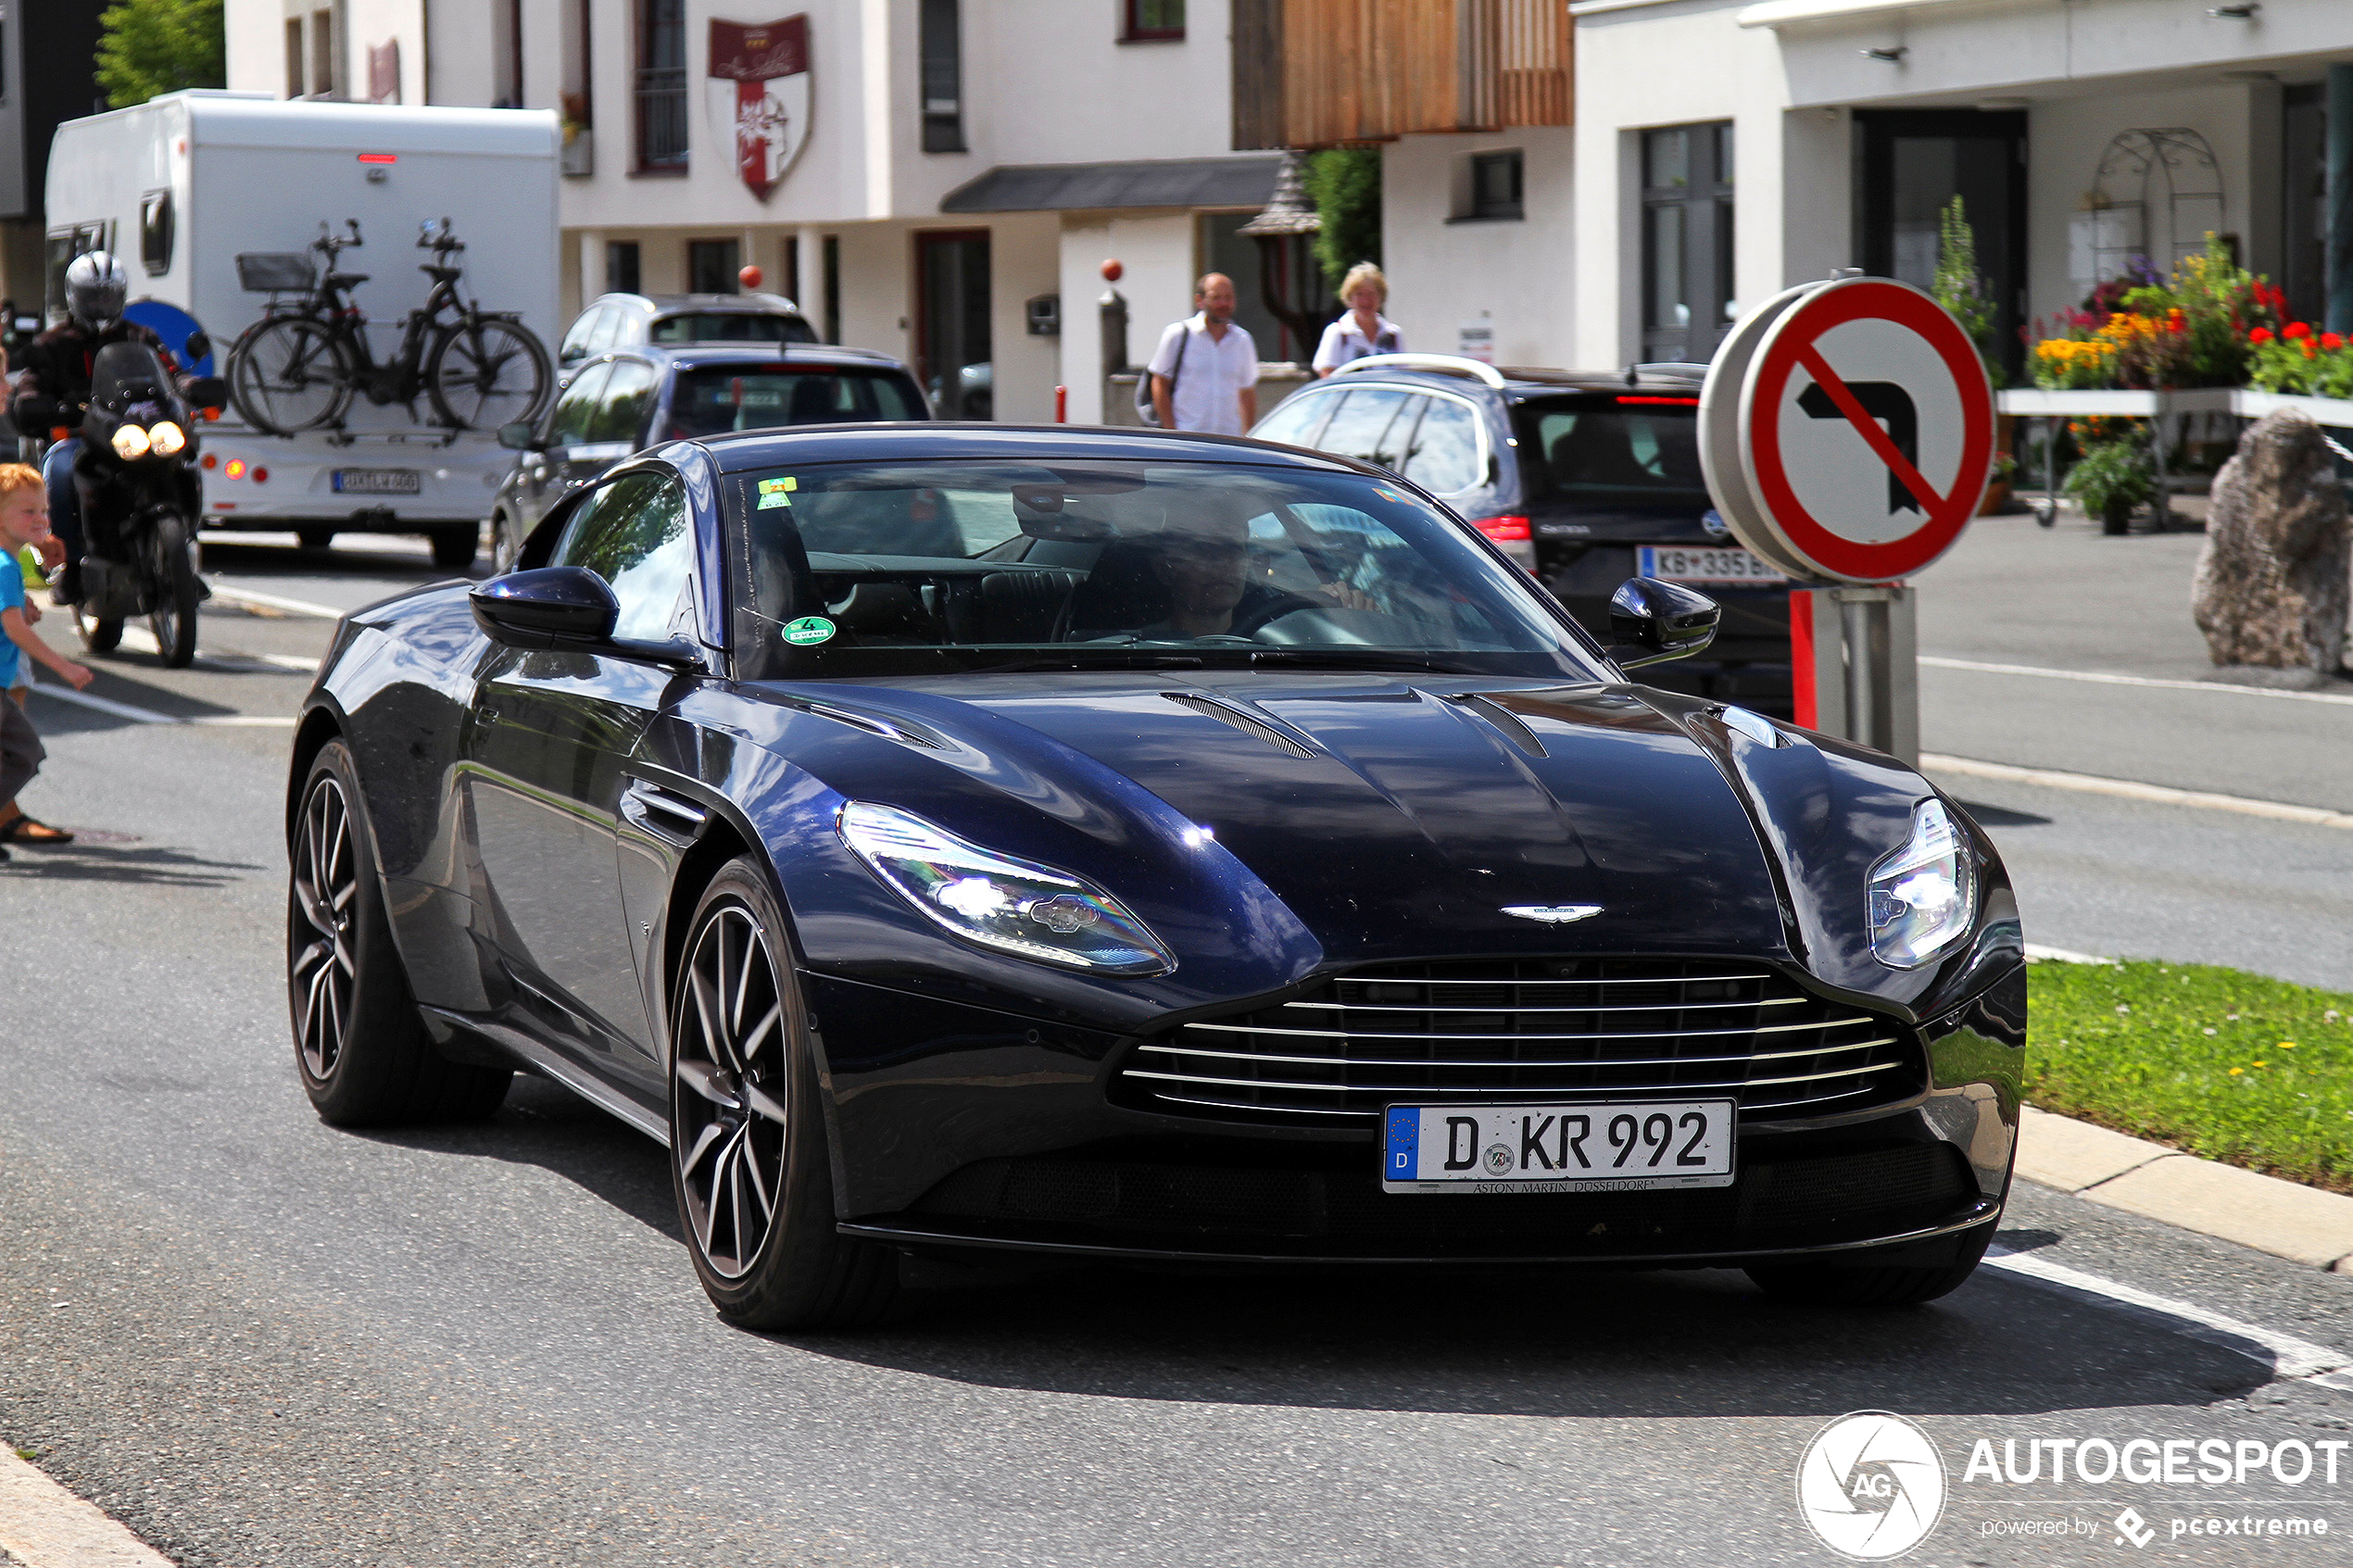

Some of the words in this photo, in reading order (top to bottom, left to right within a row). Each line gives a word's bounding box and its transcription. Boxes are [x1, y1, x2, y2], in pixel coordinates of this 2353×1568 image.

[1659, 552, 1687, 574] KB
[1704, 551, 1745, 575] 335
[801, 619, 815, 631] 4
[1443, 1116, 1479, 1171] D
[1520, 1114, 1592, 1170] KR
[1607, 1112, 1708, 1169] 992
[1396, 1153, 1408, 1169] D
[1473, 1184, 1516, 1194] ASTON
[1521, 1183, 1568, 1193] MARTIN
[1575, 1180, 1650, 1192] DÜSSELDORF
